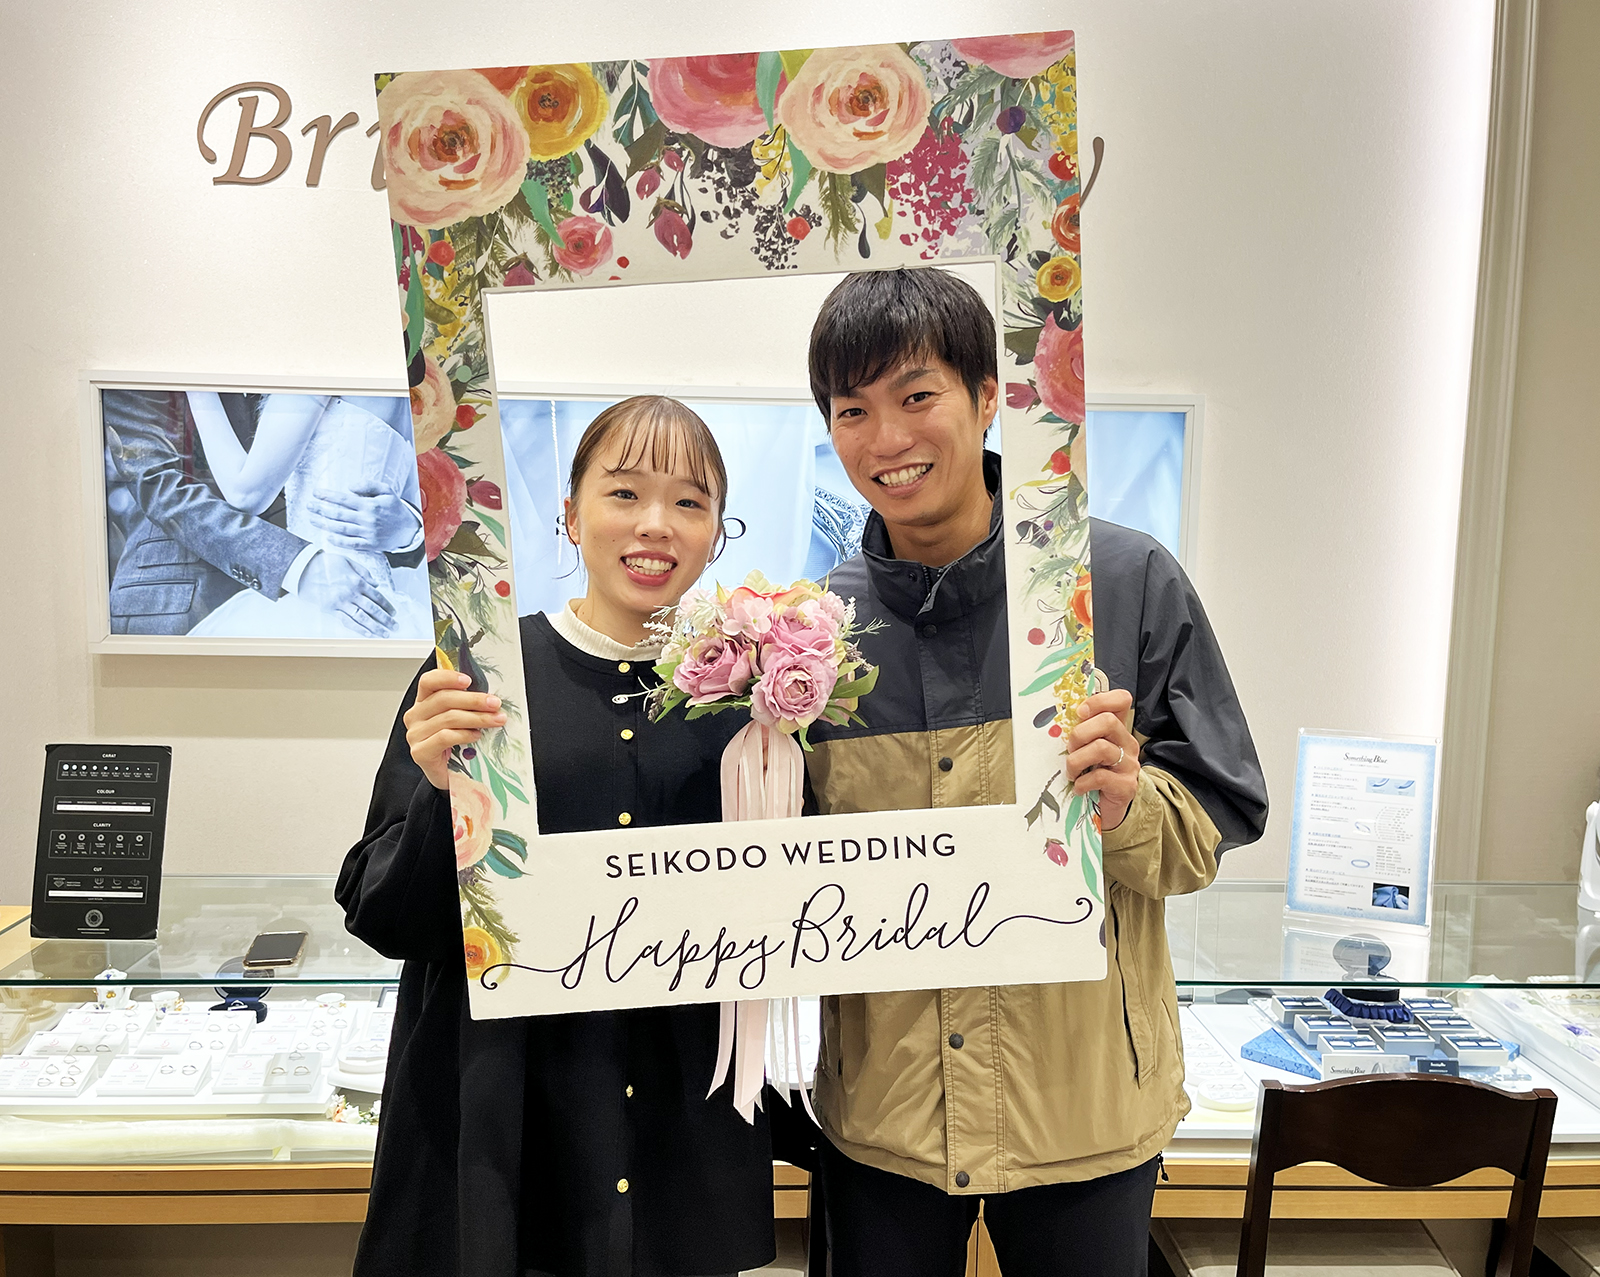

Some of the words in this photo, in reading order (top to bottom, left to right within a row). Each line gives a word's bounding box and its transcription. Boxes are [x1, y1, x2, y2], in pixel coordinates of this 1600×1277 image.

[1343, 752, 1373, 763] Something
[606, 848, 767, 879] SEIKODO
[781, 833, 956, 866] WEDDING
[552, 896, 786, 991] Happy
[790, 881, 1015, 969] Bridal
[1330, 1066, 1354, 1075] Something
